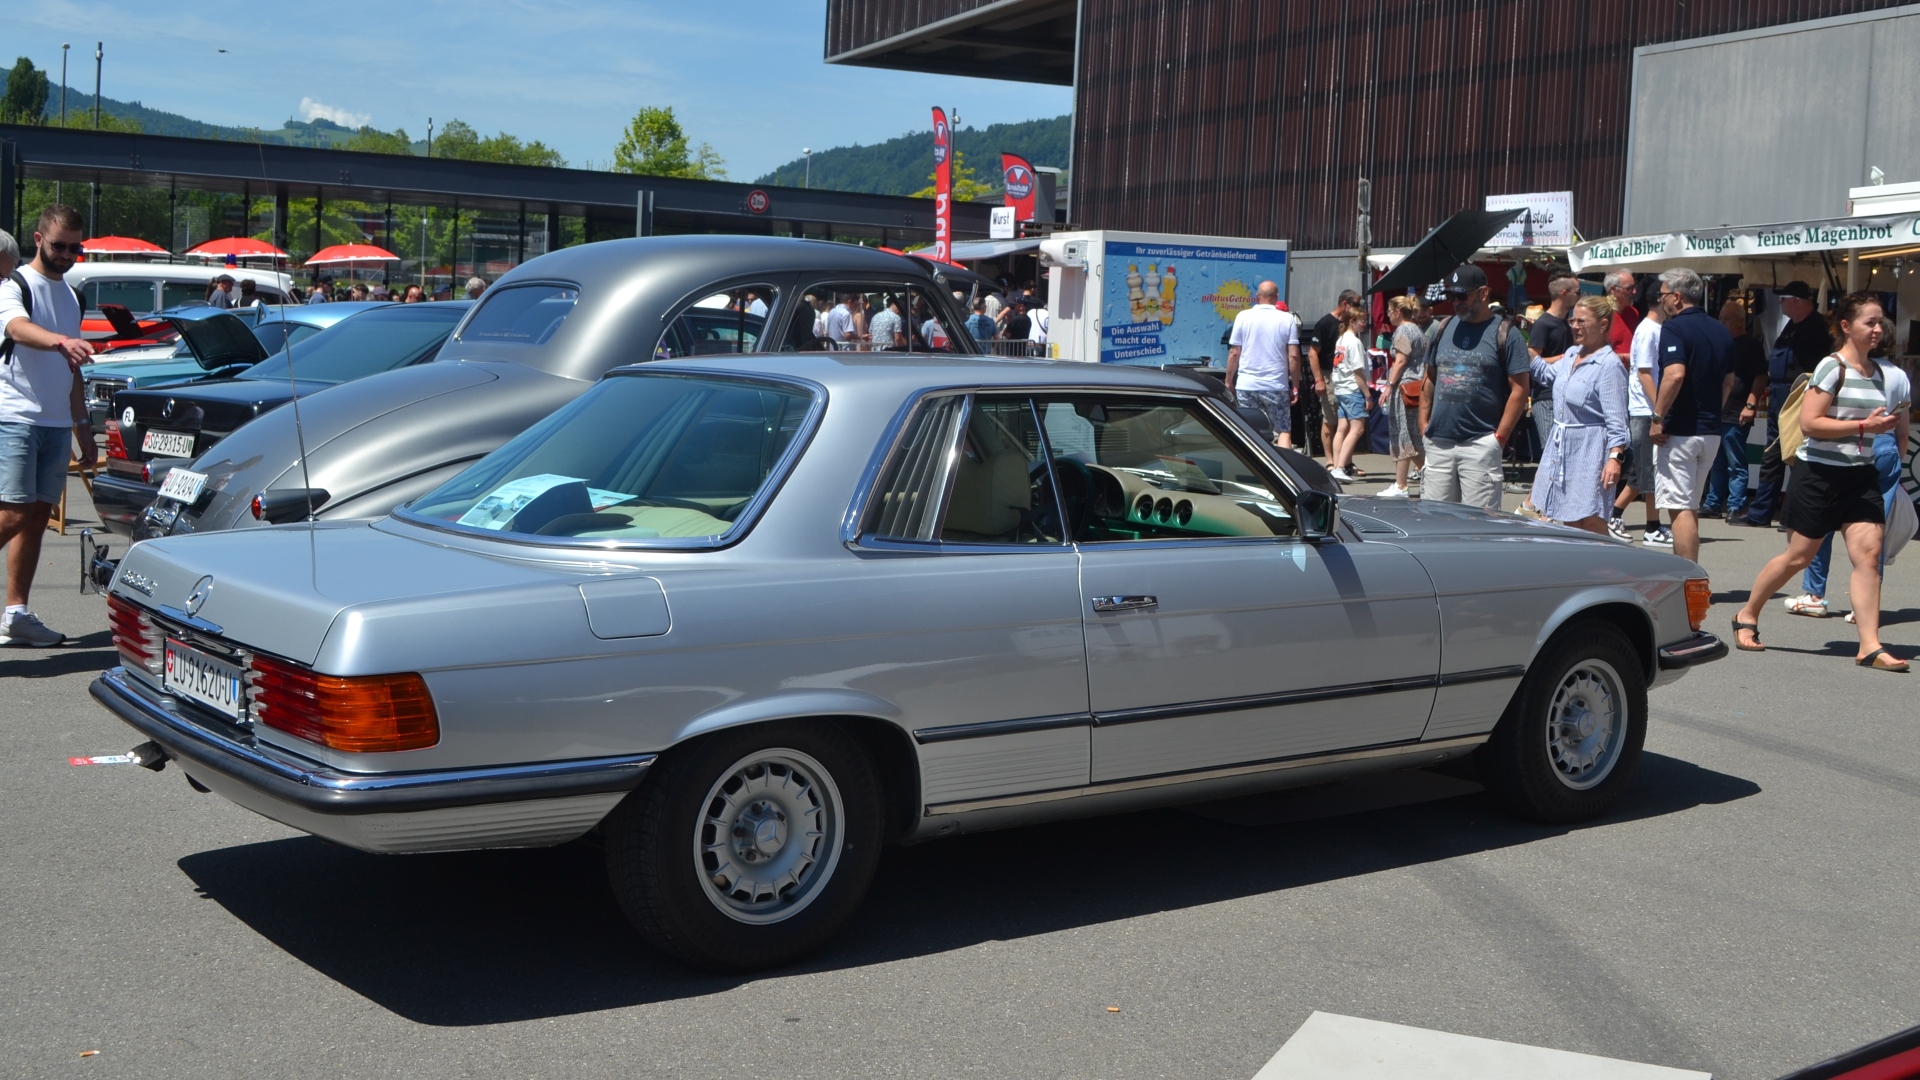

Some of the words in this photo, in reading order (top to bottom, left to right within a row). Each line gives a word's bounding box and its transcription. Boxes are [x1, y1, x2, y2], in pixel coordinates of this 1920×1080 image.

[993, 211, 1009, 225] Wurst
[1686, 233, 1735, 253] Nougat
[1757, 231, 1800, 247] feines
[1805, 223, 1892, 246] Magenbrot
[1136, 247, 1146, 255] Ihr
[1147, 248, 1194, 258] zuverlässiger
[1196, 249, 1257, 260] Getränkelieferant
[1111, 326, 1124, 335] Die
[1127, 322, 1159, 334] Auswahl
[1114, 336, 1139, 344] macht
[1141, 336, 1156, 344] den
[1114, 345, 1164, 358] Unterschied.
[125, 411, 132, 422] FL
